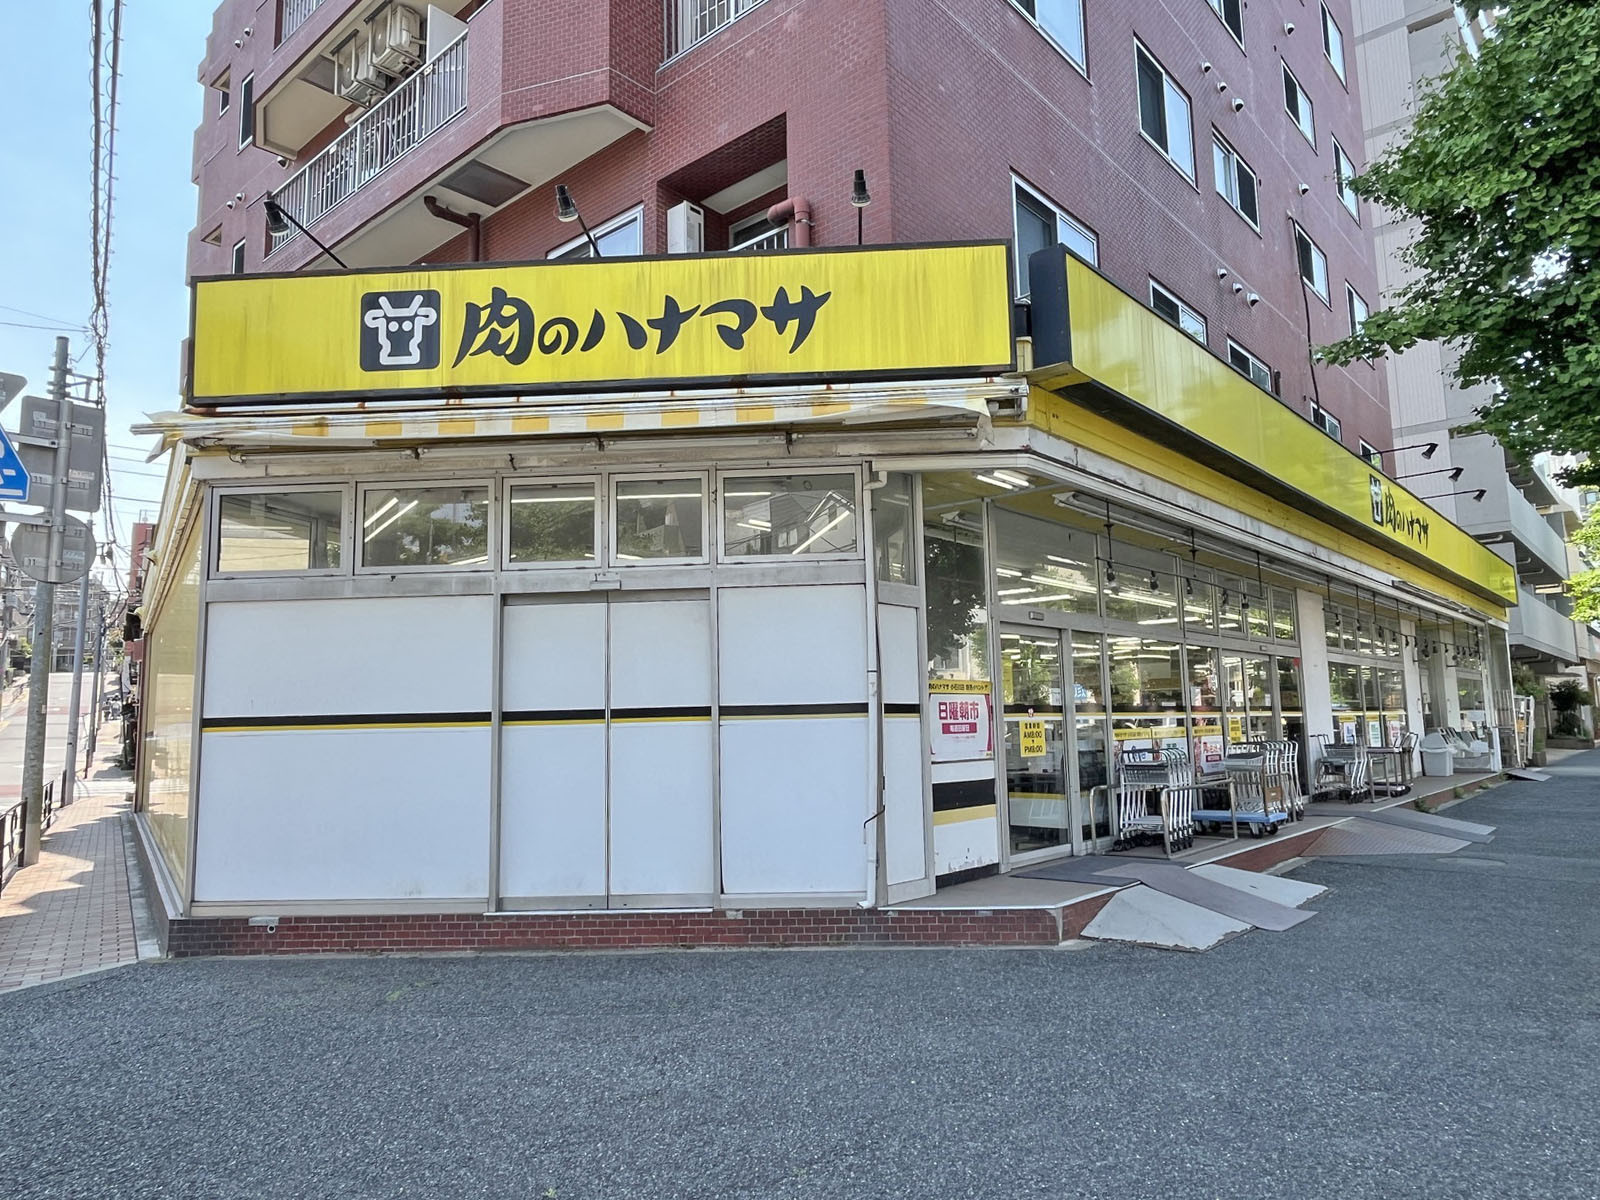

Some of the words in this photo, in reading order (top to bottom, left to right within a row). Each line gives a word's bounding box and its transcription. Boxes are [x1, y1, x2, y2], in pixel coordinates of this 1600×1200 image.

[451, 285, 832, 369] 肉のハナマサ
[1384, 486, 1429, 550] 肉のハナマサ
[938, 701, 979, 720] 日曜朝市
